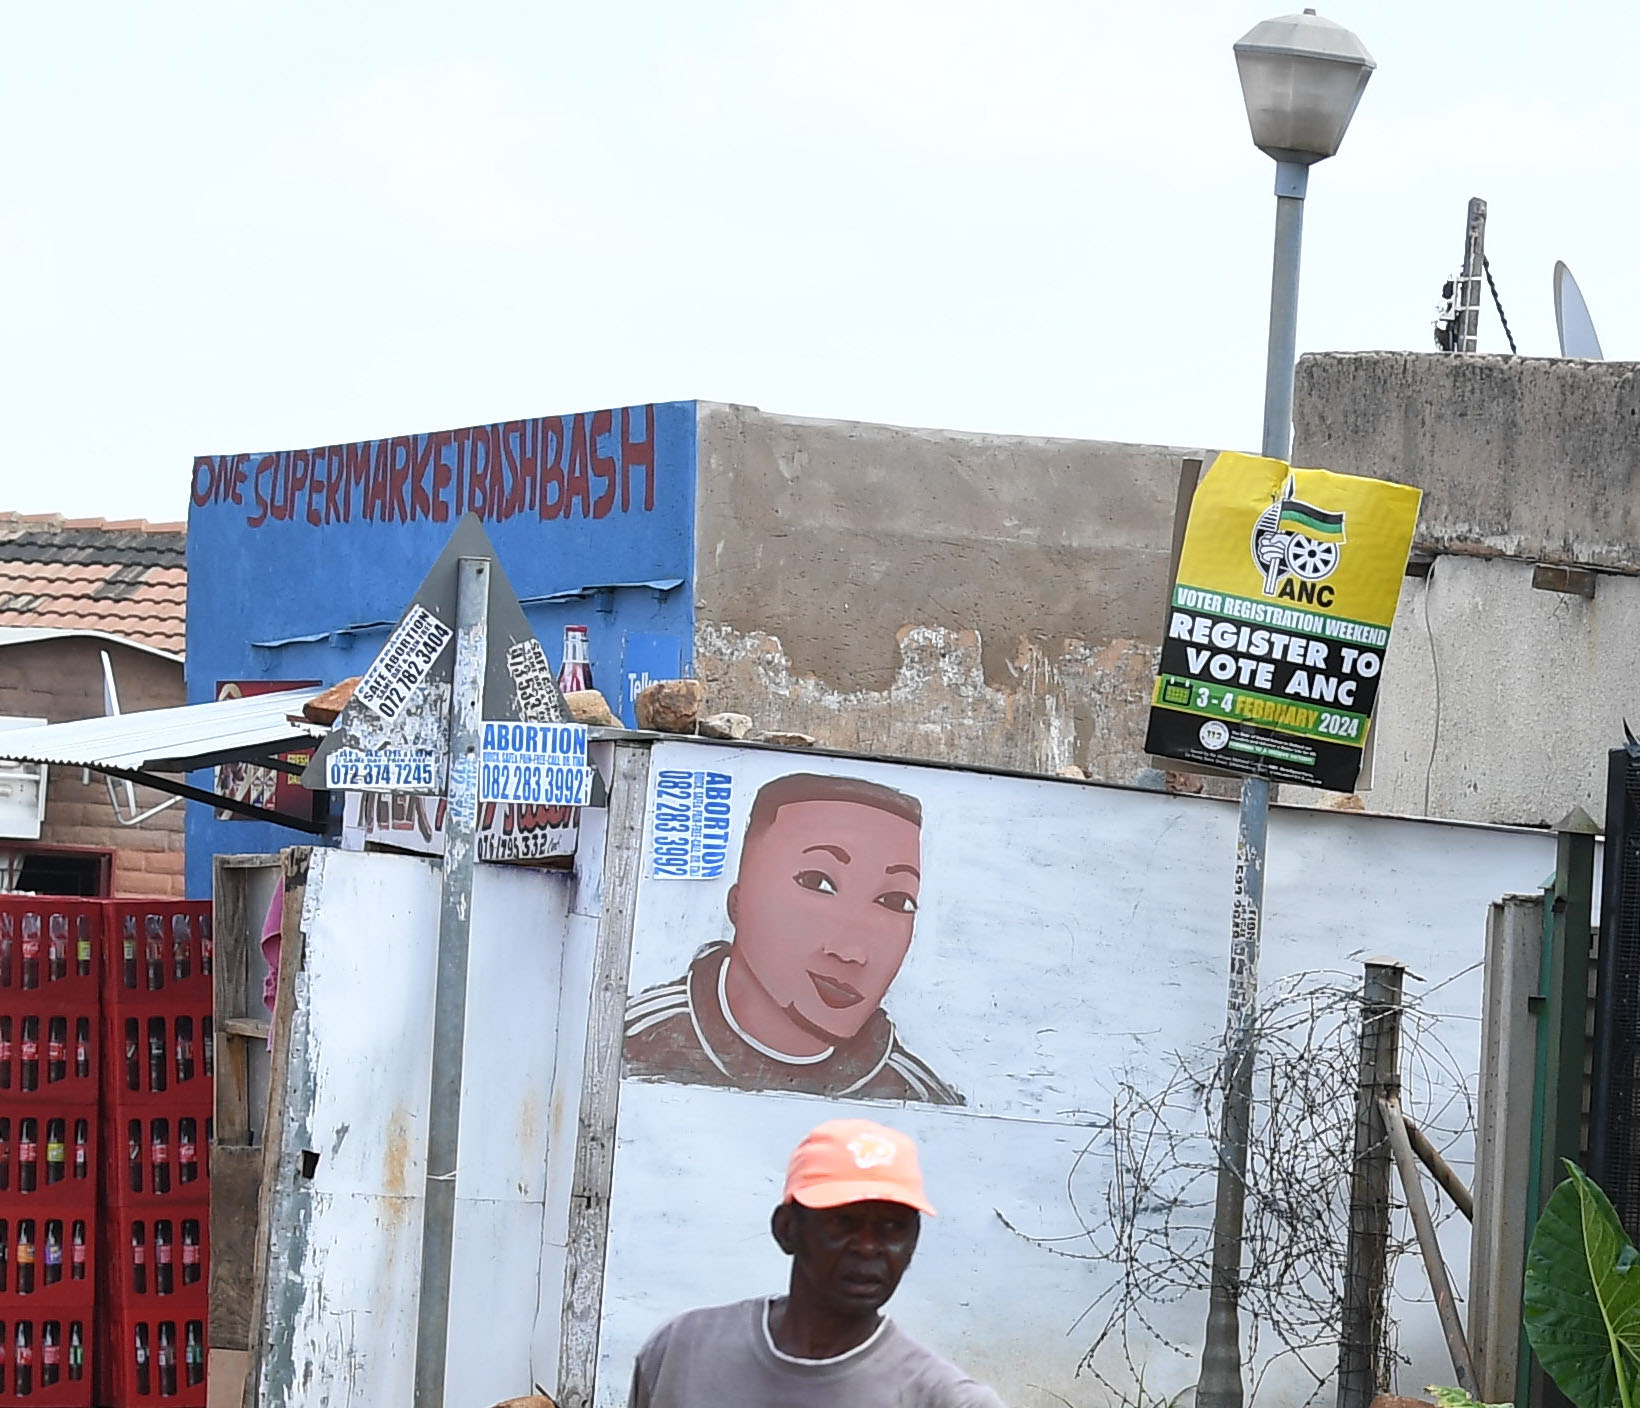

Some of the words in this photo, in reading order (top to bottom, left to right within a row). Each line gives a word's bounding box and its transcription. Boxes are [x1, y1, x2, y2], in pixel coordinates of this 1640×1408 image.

[191, 453, 250, 507] ONE
[1278, 577, 1335, 608] ANC
[1178, 587, 1222, 612] VOTER
[1223, 597, 1323, 633] REGISTRATION
[1325, 620, 1388, 646] WEEKEND
[363, 671, 388, 702] SAFE
[384, 610, 430, 673] ABORTION
[1169, 612, 1328, 670] REGISTER
[1340, 647, 1380, 677] TO
[379, 687, 406, 718] 072
[396, 661, 424, 691] 782
[415, 623, 450, 665] 3404
[1186, 647, 1275, 689] VOTE
[1285, 670, 1357, 706] ANC
[1235, 695, 1319, 729] FEBRUARY
[1318, 712, 1359, 738] 2024
[483, 724, 586, 755] ABORTION
[330, 764, 359, 785] 072
[395, 764, 433, 785] 7245
[482, 764, 509, 800] 082
[513, 765, 541, 802] 283
[545, 767, 584, 804] 3992
[657, 770, 693, 799] 082
[655, 803, 691, 832] 283
[701, 772, 732, 877] ABORTION
[653, 836, 689, 876] 3992
